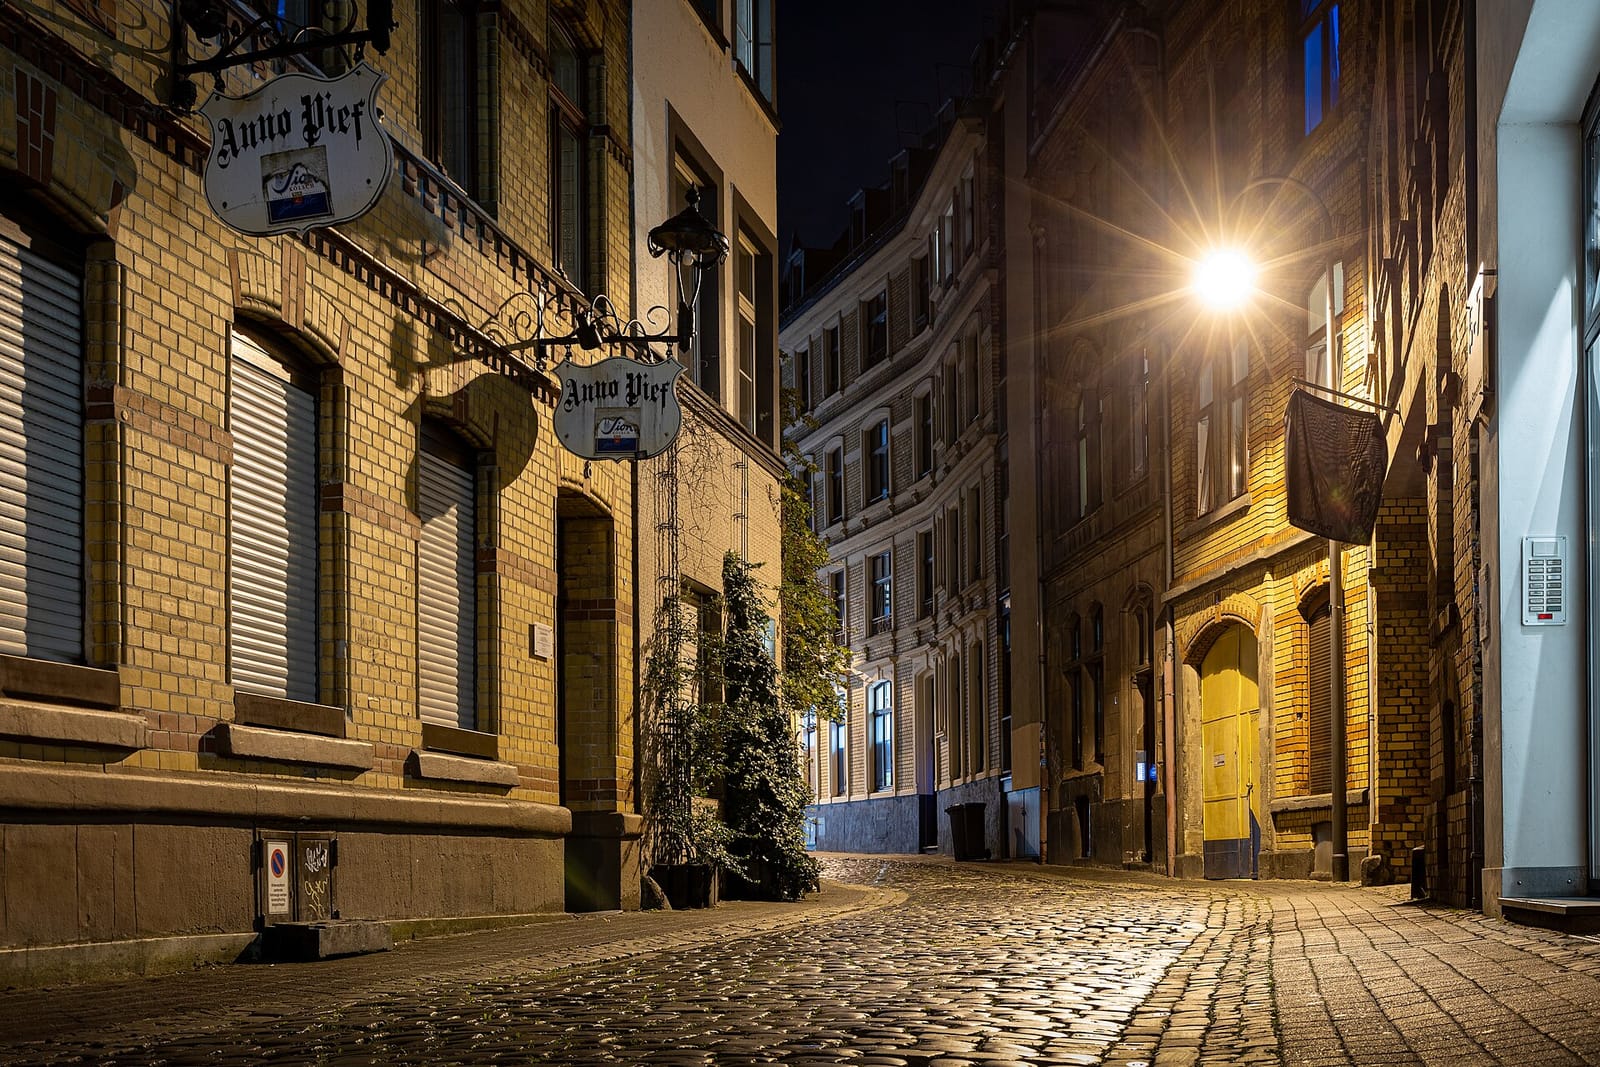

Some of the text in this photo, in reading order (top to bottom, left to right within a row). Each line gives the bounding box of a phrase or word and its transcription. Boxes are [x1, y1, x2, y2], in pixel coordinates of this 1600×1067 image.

[217, 109, 292, 169] Anno
[563, 378, 620, 413] Anno
[601, 416, 634, 435] Sion
